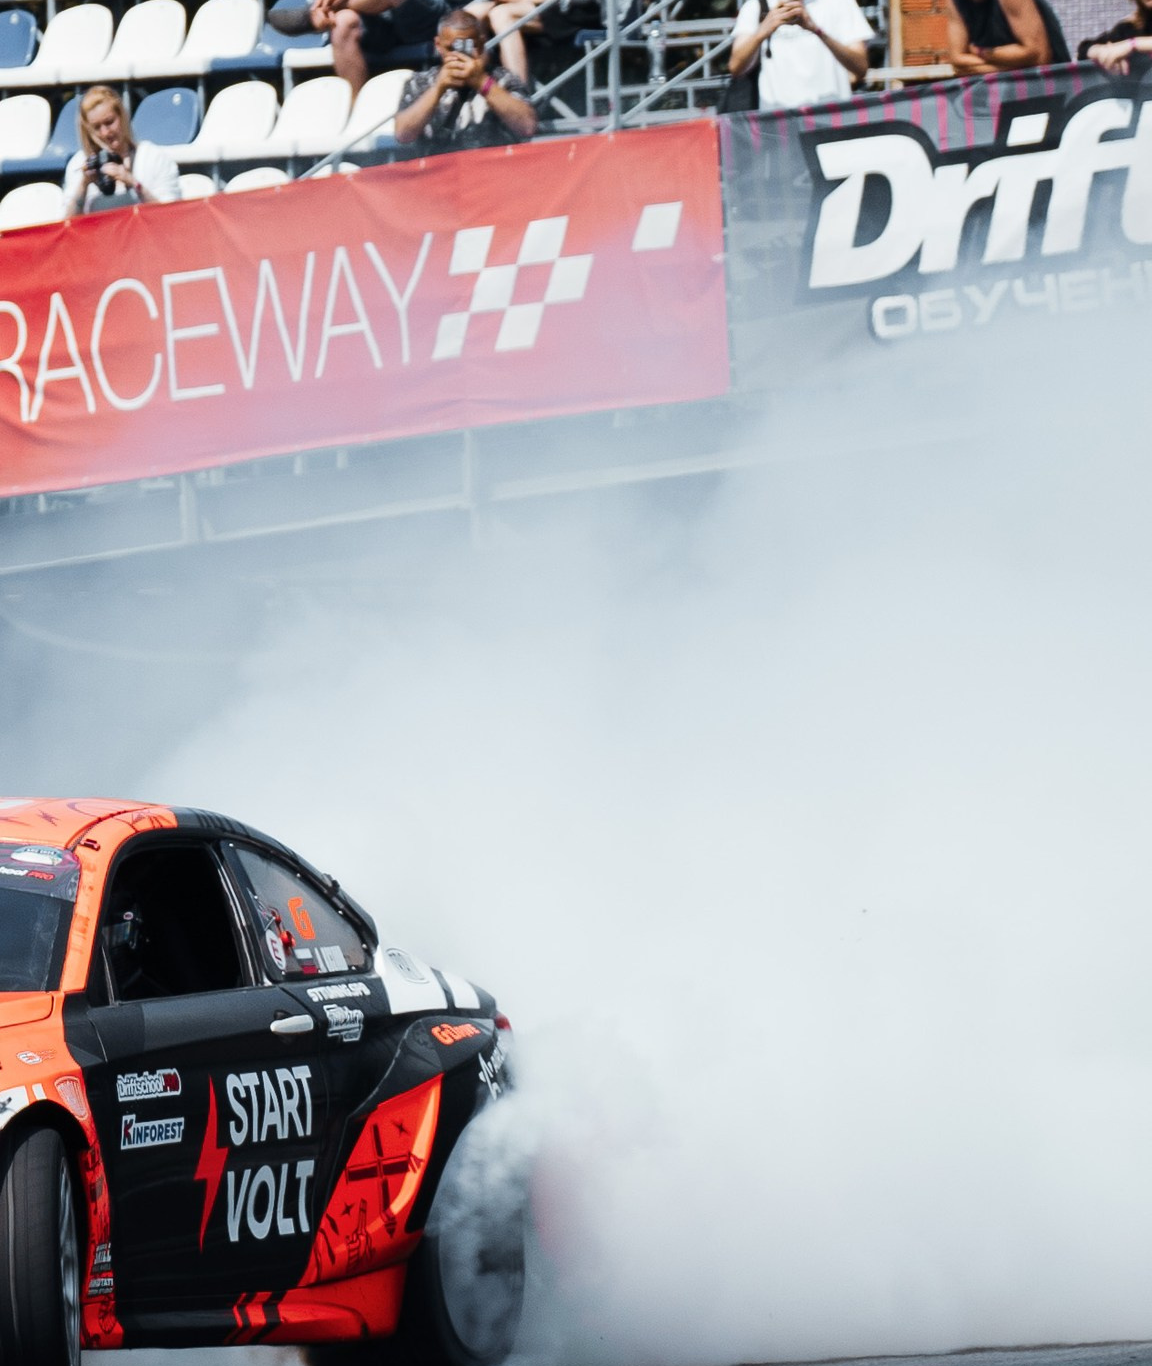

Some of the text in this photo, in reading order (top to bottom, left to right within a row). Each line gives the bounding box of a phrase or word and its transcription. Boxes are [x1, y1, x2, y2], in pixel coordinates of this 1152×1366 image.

[872, 260, 1152, 339] ОБУЧЕН
[122, 1118, 183, 1146] KINFOREST
[226, 1065, 313, 1146] START
[227, 1159, 315, 1242] VOLT
